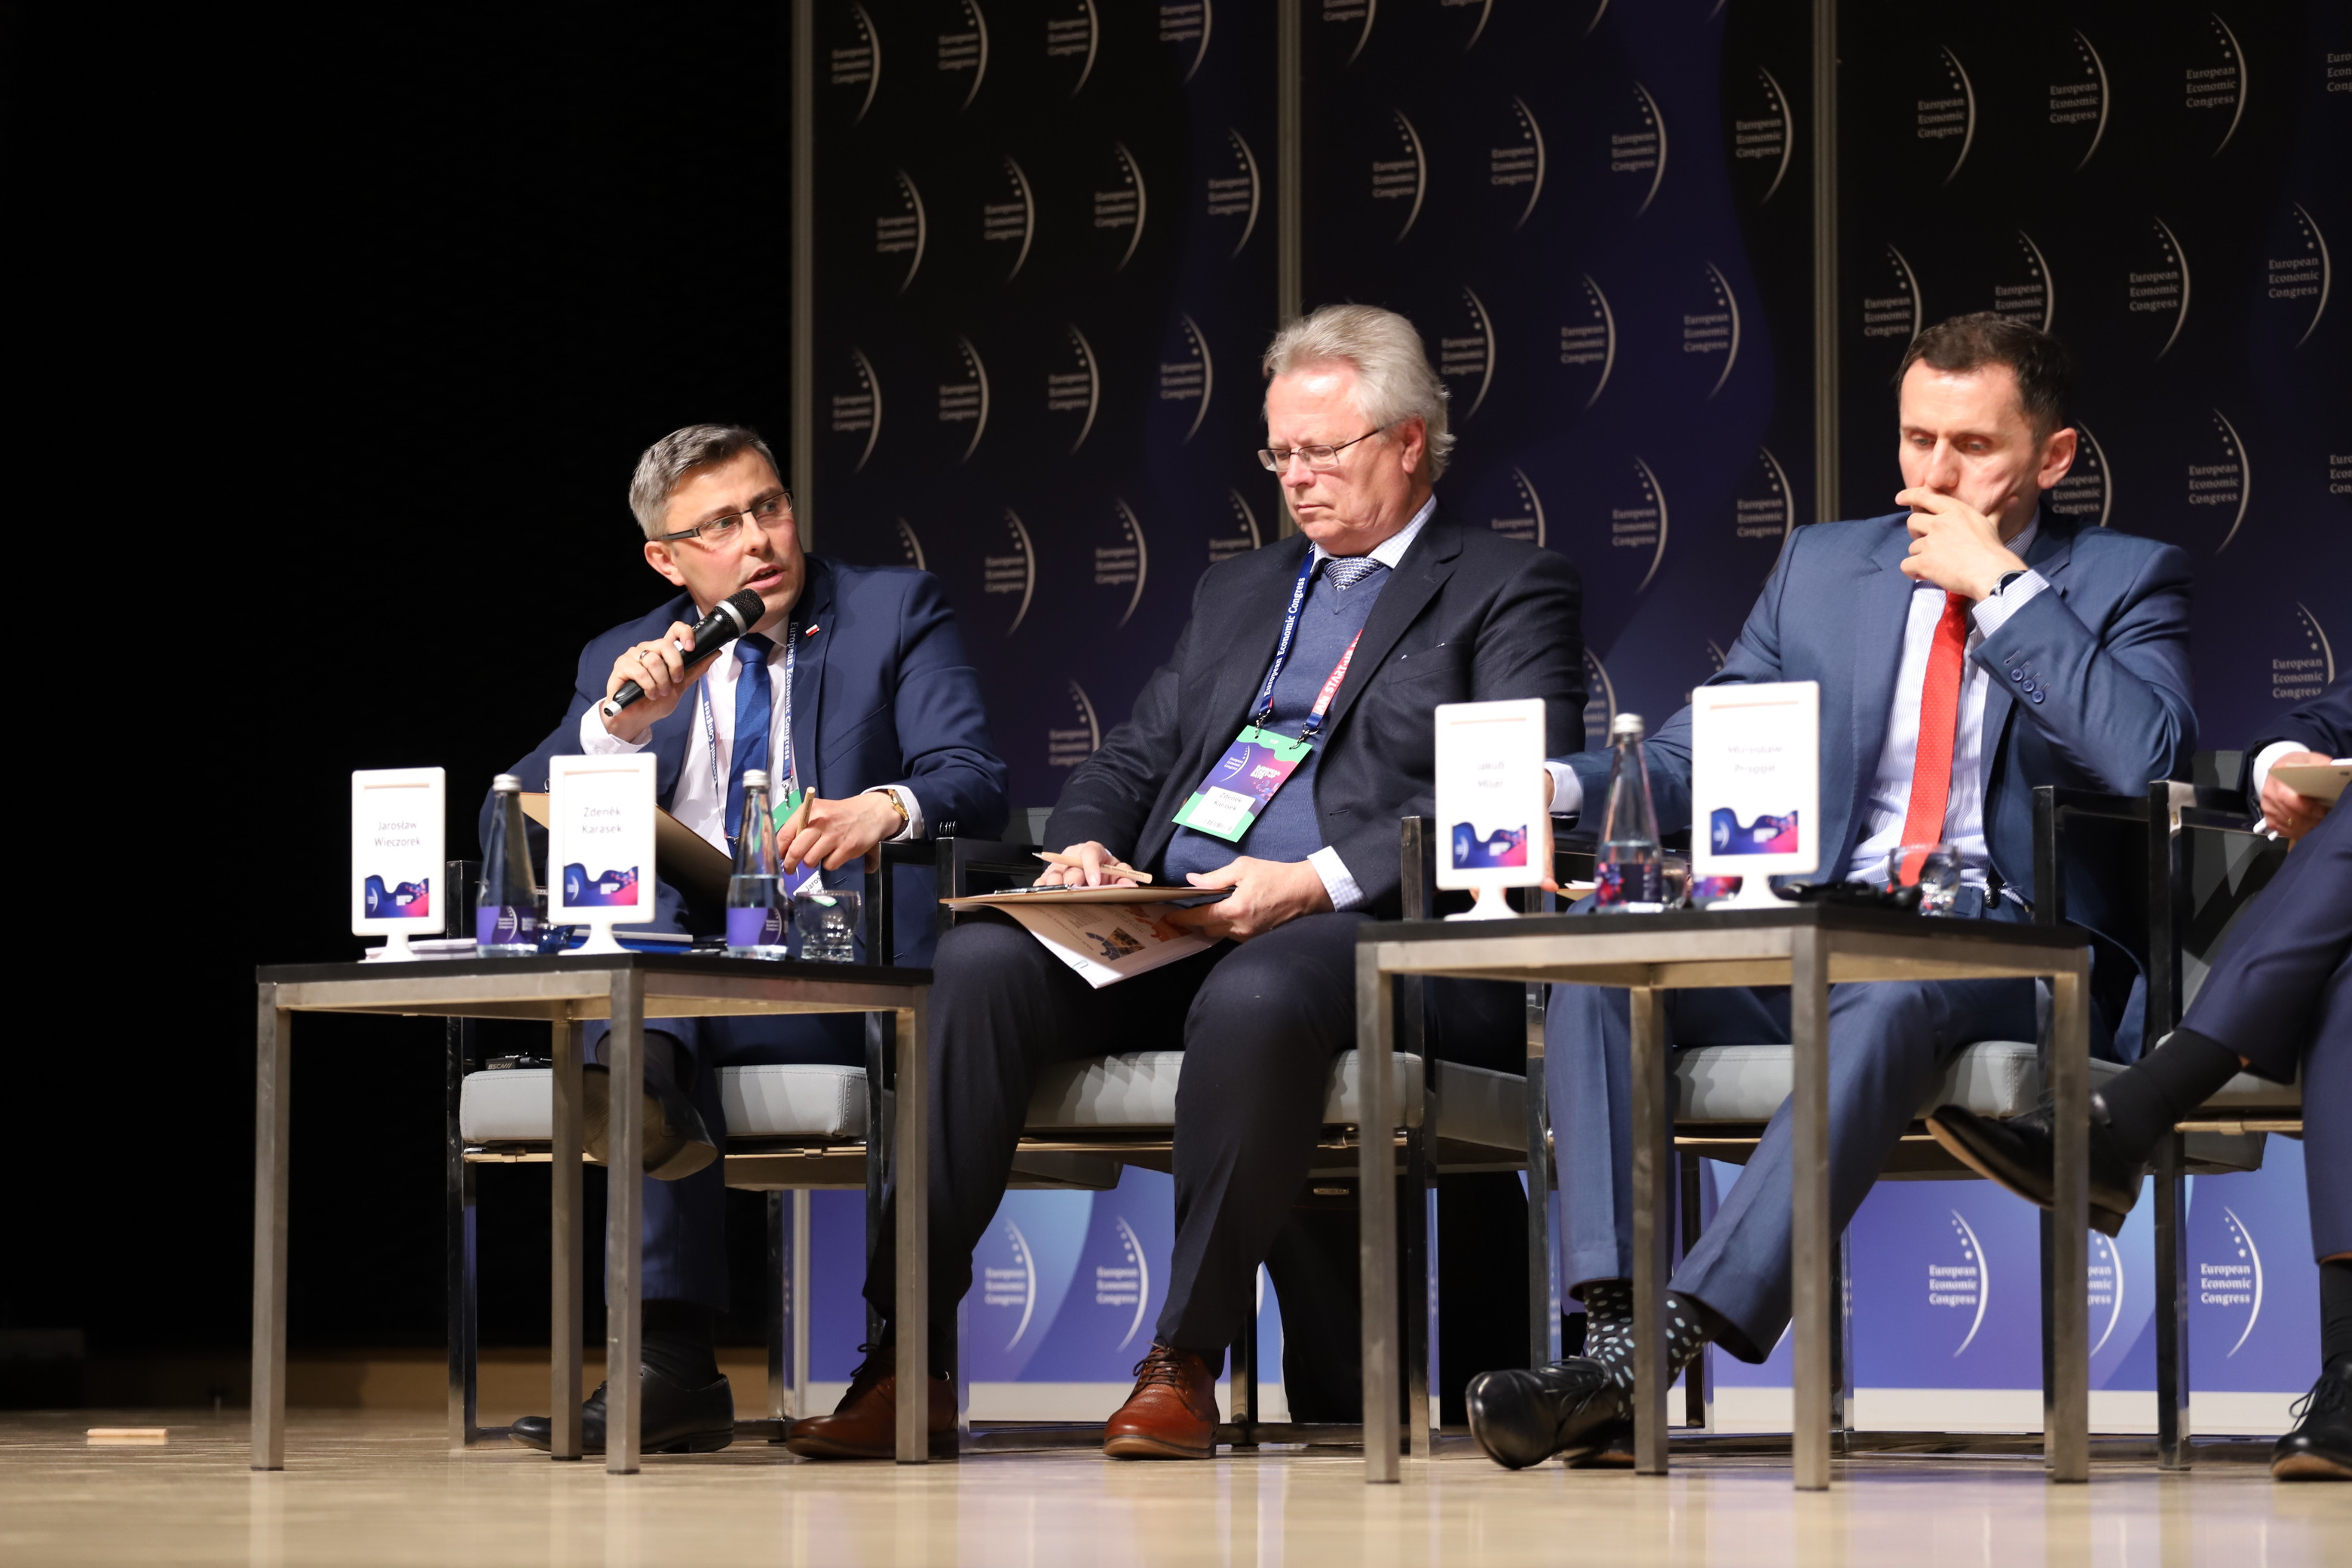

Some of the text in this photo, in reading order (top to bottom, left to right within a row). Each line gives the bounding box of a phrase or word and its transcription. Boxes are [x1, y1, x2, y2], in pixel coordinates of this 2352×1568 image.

[2327, 53, 2352, 63] Euro
[2185, 67, 2236, 79] European
[2327, 68, 2352, 78] Econ
[2050, 83, 2099, 95] European
[2186, 79, 2237, 93] Economic
[2050, 96, 2099, 109] Economic
[2185, 96, 2235, 108] Congress
[2049, 112, 2098, 124] Congress
[2268, 258, 2320, 269] European
[2129, 271, 2179, 283] European
[2268, 271, 2319, 283] Economic
[1995, 284, 2044, 297] European
[2129, 283, 2179, 297] Economic
[2268, 286, 2319, 299] Congress
[1995, 298, 2044, 311] Economic
[2129, 300, 2179, 312] Congress
[2188, 464, 2239, 476] European
[2188, 477, 2239, 490] Economic
[2052, 488, 2101, 501] Economic
[2188, 493, 2238, 505] Congress
[2052, 503, 2100, 516] Congress
[1263, 577, 1306, 697] European Economic Congress
[786, 622, 798, 666] European
[2272, 659, 2323, 670] European
[2272, 672, 2324, 684] Economic
[786, 667, 794, 715] Economic
[703, 700, 715, 742] Congress
[374, 836, 421, 847] Wieczorek
[805, 876, 822, 891] Jaros
[1928, 1265, 1977, 1279] European
[2200, 1263, 2251, 1277] European
[1929, 1279, 1977, 1291] Economic
[2200, 1278, 2252, 1289] Economic
[1928, 1293, 1977, 1307] Congress
[2200, 1292, 2251, 1306] Congress
